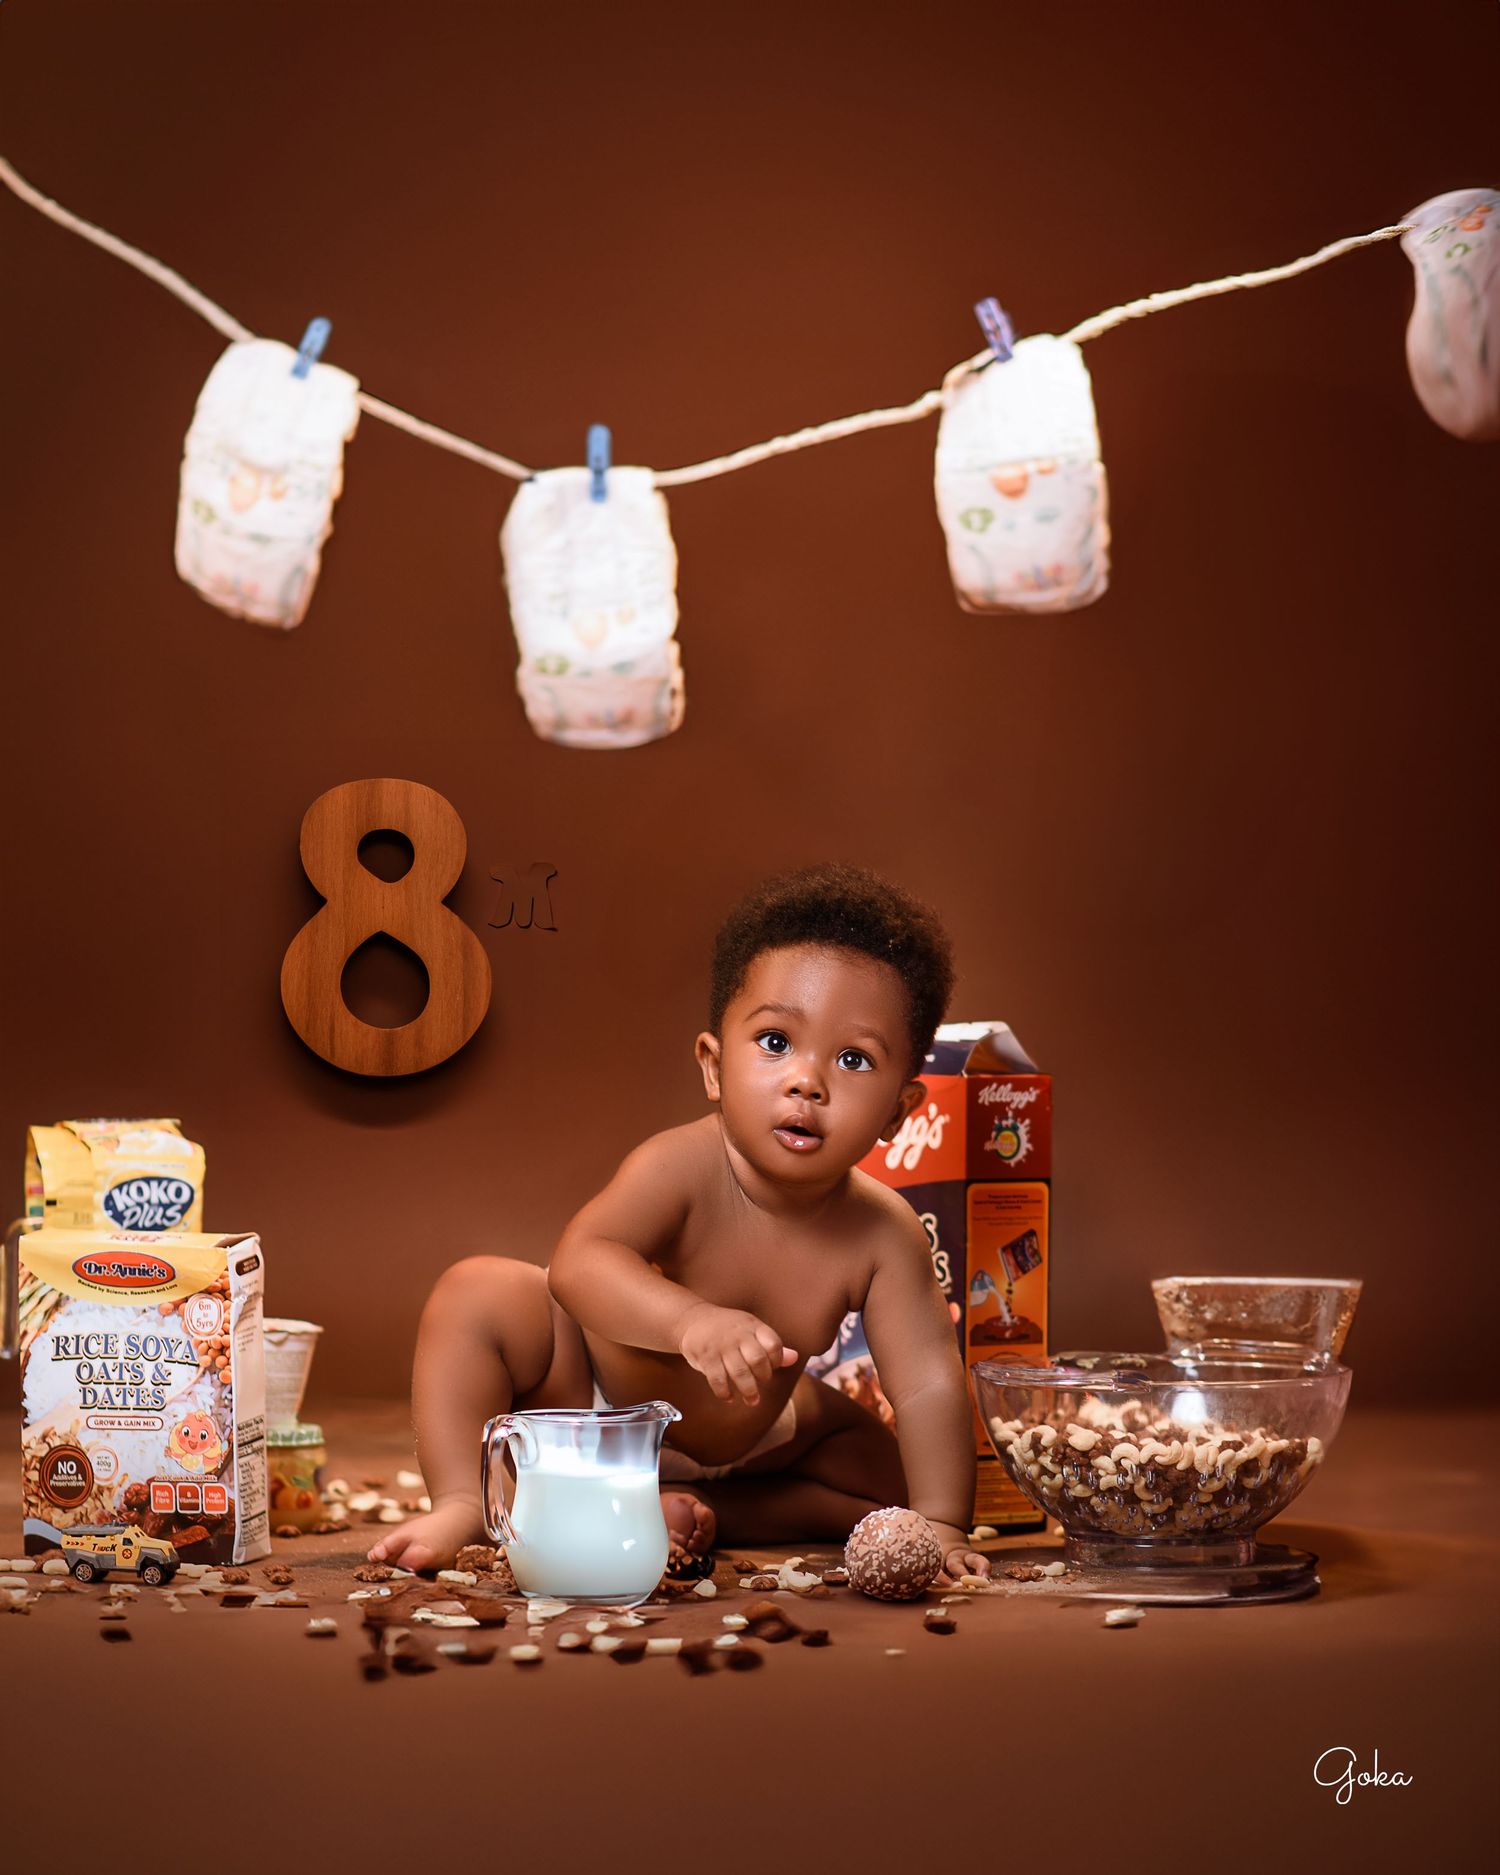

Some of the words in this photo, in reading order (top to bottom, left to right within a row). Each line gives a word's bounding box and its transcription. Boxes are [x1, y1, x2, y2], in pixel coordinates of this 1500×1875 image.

[281, 777, 492, 1077] 8
[978, 1082, 1037, 1109] Kellogg's
[111, 1180, 192, 1211] KOKO
[83, 1261, 110, 1276] Dr.
[111, 1262, 167, 1278] Annie's
[52, 1333, 119, 1361] RICE
[124, 1333, 199, 1366] SOYA
[75, 1361, 145, 1385] OATS
[151, 1362, 172, 1386] &
[79, 1386, 167, 1411] DATES
[93, 1419, 116, 1427] GROW
[57, 1460, 77, 1475] NO
